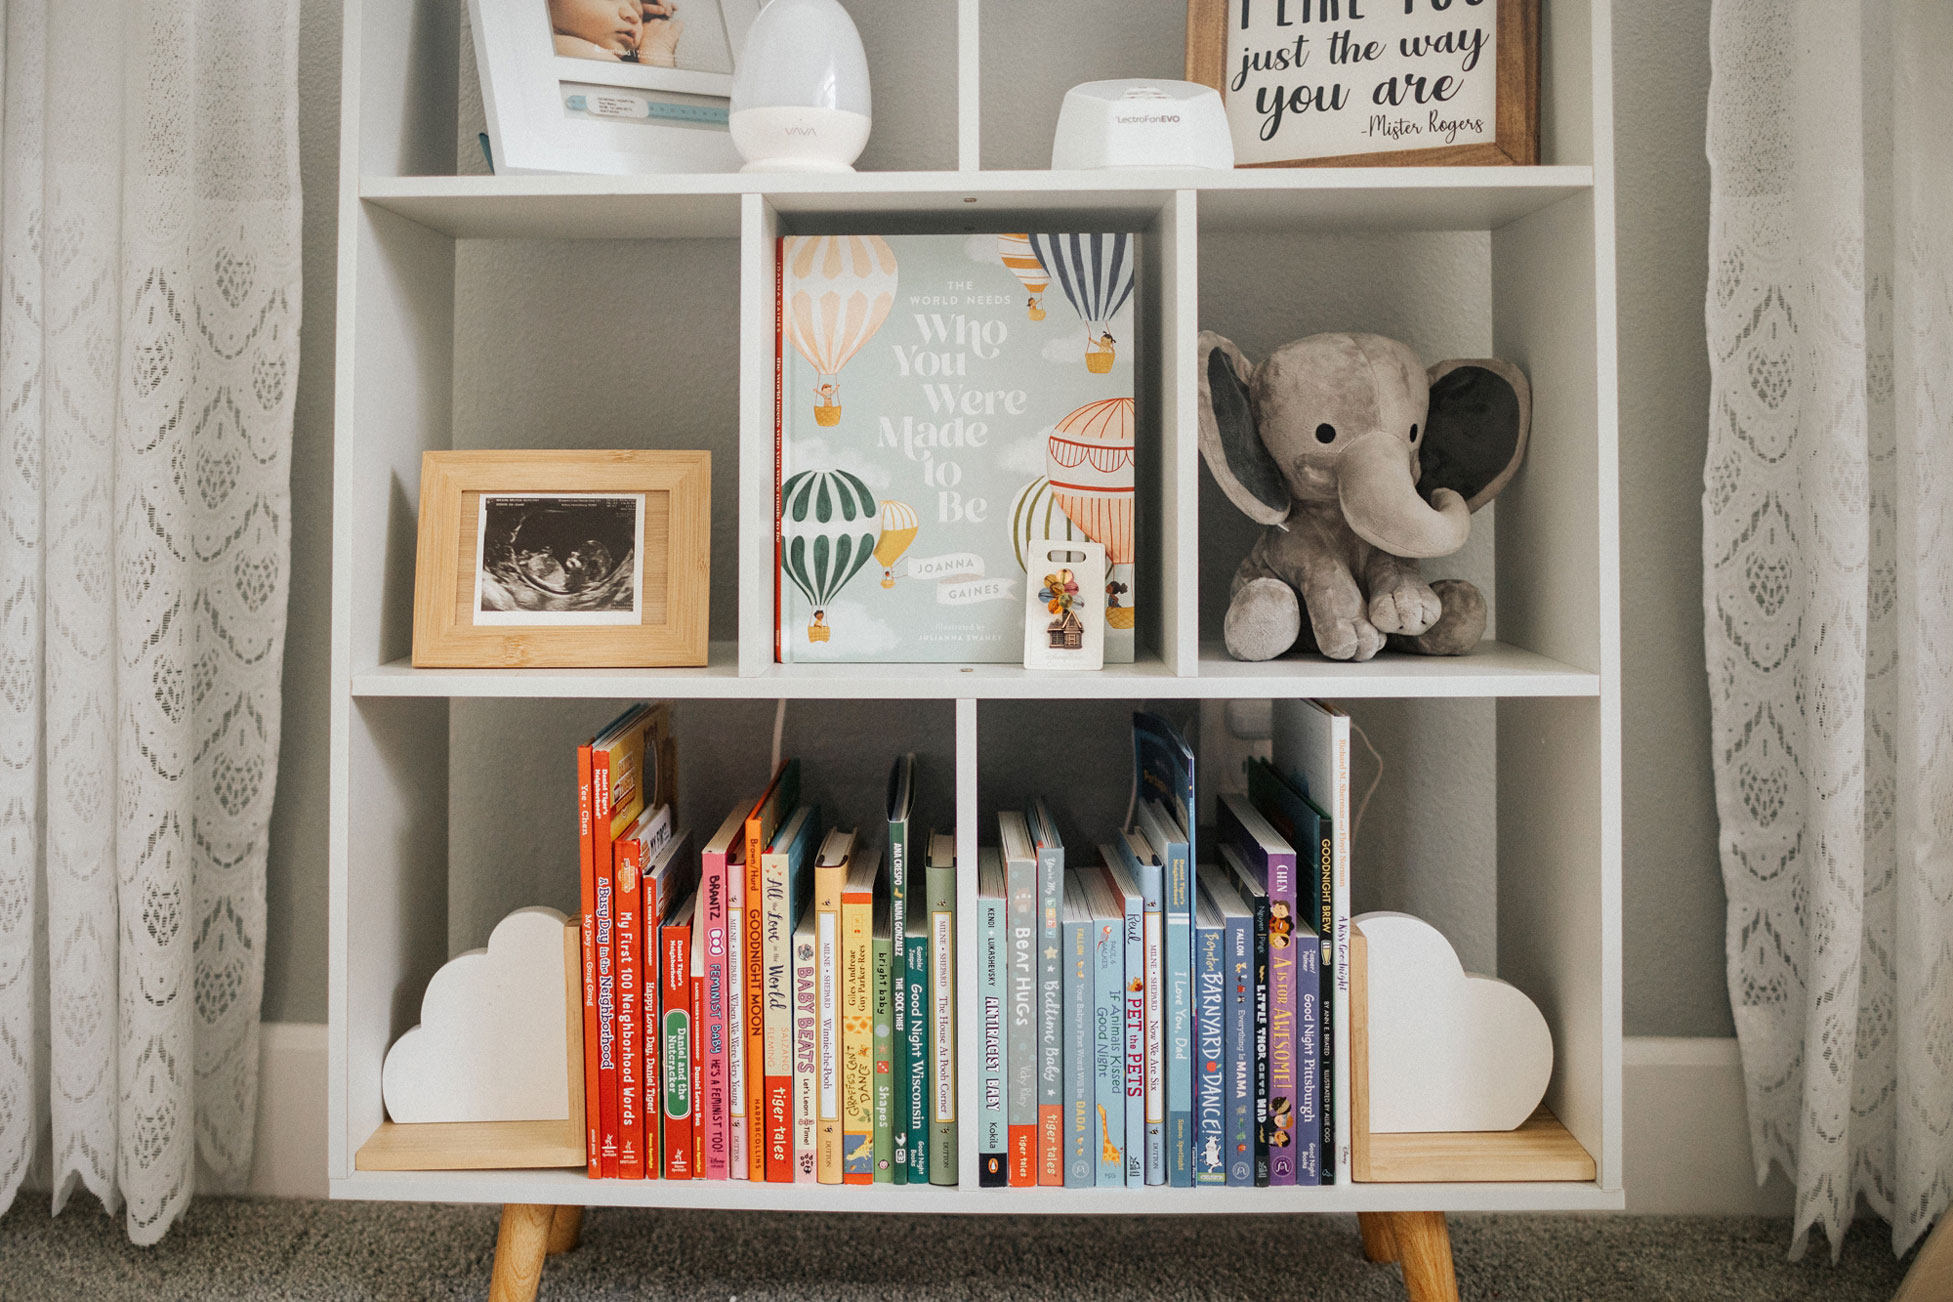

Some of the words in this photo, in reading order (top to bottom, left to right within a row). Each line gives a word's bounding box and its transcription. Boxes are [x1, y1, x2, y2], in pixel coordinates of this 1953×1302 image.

[1231, 34, 1309, 92] just
[1327, 29, 1386, 64] the
[1400, 27, 1490, 72] way
[1256, 82, 1350, 141] you
[1372, 73, 1464, 106] are
[1428, 109, 1484, 143] Rogers
[910, 296, 959, 305] WORLD
[967, 296, 1011, 304] NEEDS
[947, 281, 974, 290] THE
[914, 314, 1008, 359] Who
[891, 345, 966, 376] You
[923, 384, 1027, 415] Were
[877, 416, 988, 461] Made
[938, 491, 988, 523] Be
[918, 559, 974, 574] JOANNA
[948, 584, 999, 599] GAINES
[750, 838, 758, 891] Brown/Hurd
[894, 843, 902, 858] ANA
[599, 877, 609, 885] A
[894, 859, 903, 885] CRESPO
[1277, 865, 1288, 892] CHEN
[1322, 839, 1331, 903] GOODNIGHT
[596, 886, 610, 917] Busy
[709, 875, 720, 920] BRANTZ
[894, 901, 903, 920] NANA
[598, 919, 611, 944] Day
[618, 912, 632, 928] My
[1127, 913, 1141, 944] Reul
[1322, 905, 1331, 933] BREW
[600, 946, 609, 956] in
[620, 933, 632, 962] First
[750, 909, 761, 990] GOODNIGHT
[894, 921, 903, 956] GONZALEZ
[1201, 932, 1219, 972] Boynton
[1236, 929, 1244, 956] FALLON
[600, 958, 610, 975] the
[877, 952, 886, 986] bright
[1274, 957, 1292, 969] A
[1277, 972, 1287, 980] IS
[621, 968, 633, 989] 100
[710, 964, 721, 1019] FEMINIST
[797, 966, 814, 1013] BABY
[895, 978, 903, 990] THE
[1175, 981, 1187, 1005] Love
[644, 982, 654, 1011] Happy
[730, 993, 739, 1019] When
[877, 989, 887, 1015] baby
[895, 991, 904, 1012] SOCK
[911, 984, 922, 1016] Good
[939, 996, 948, 1013] The
[1109, 990, 1121, 1001] If
[1277, 985, 1288, 1003] FOR
[1304, 993, 1315, 1021] Good
[599, 976, 615, 1070] Neighborhood
[645, 1013, 655, 1036] Love
[751, 994, 761, 1036] MOON
[895, 1013, 904, 1031] THIEF
[1045, 980, 1059, 1045] Bedtime
[1097, 1007, 1108, 1040] Good
[1111, 1004, 1121, 1051] Animals
[1127, 998, 1142, 1032] PET
[1174, 1009, 1186, 1033] You,
[1201, 972, 1223, 1059] BARNYARD
[619, 993, 635, 1083] Neighborhood
[711, 1024, 721, 1054] BABY
[731, 1021, 739, 1035] We
[908, 1020, 922, 1057] Night
[940, 1016, 948, 1044] House
[985, 996, 999, 1072] ANTIRACIST
[1130, 1034, 1138, 1049] the
[1150, 1021, 1158, 1040] Now
[1236, 1010, 1245, 1051] Everything
[1301, 1025, 1314, 1055] Night
[678, 1028, 686, 1059] Daniel
[731, 1036, 739, 1058] Were
[767, 1026, 775, 1068] FLEMING
[797, 1018, 814, 1073] BEATS
[823, 1018, 832, 1089] Winnie-the-Pooh
[940, 1046, 948, 1057] At
[1150, 1042, 1158, 1056] We
[1175, 1038, 1187, 1059] Dad
[1272, 1008, 1292, 1089] AWESOME!
[645, 1057, 655, 1087] Daniel
[668, 1035, 677, 1093] Nutcracker
[711, 1059, 720, 1077] HE'S
[731, 1059, 739, 1078] Very
[940, 1059, 949, 1081] Pooh
[1044, 1048, 1059, 1082] Baby
[1097, 1044, 1108, 1078] Night
[1110, 1055, 1122, 1094] Kissed
[1128, 1053, 1142, 1097] PETS
[1150, 1059, 1158, 1075] Are
[678, 1084, 687, 1100] the
[731, 1080, 740, 1106] Young
[858, 1064, 870, 1103] DANCE
[912, 1060, 924, 1129] Wisconsin
[986, 1078, 999, 1111] BABY
[1150, 1078, 1159, 1091] Six
[1237, 1061, 1246, 1098] MAMA
[1300, 1059, 1315, 1122] Pittsburgh
[623, 1087, 635, 1126] Words
[645, 1088, 656, 1114] Tiger!
[711, 1088, 722, 1128] FEMINIST
[772, 1087, 785, 1122] tiger
[876, 1085, 889, 1128] Shapes
[940, 1083, 949, 1113] Corner
[1201, 1072, 1222, 1134] DANCE!
[712, 1131, 724, 1152] TOO!
[774, 1126, 786, 1161] tales
[989, 1122, 997, 1149] Kokila
[1046, 1114, 1057, 1143] tiger
[1019, 1135, 1027, 1155] tiger
[1047, 1146, 1058, 1175] tales
